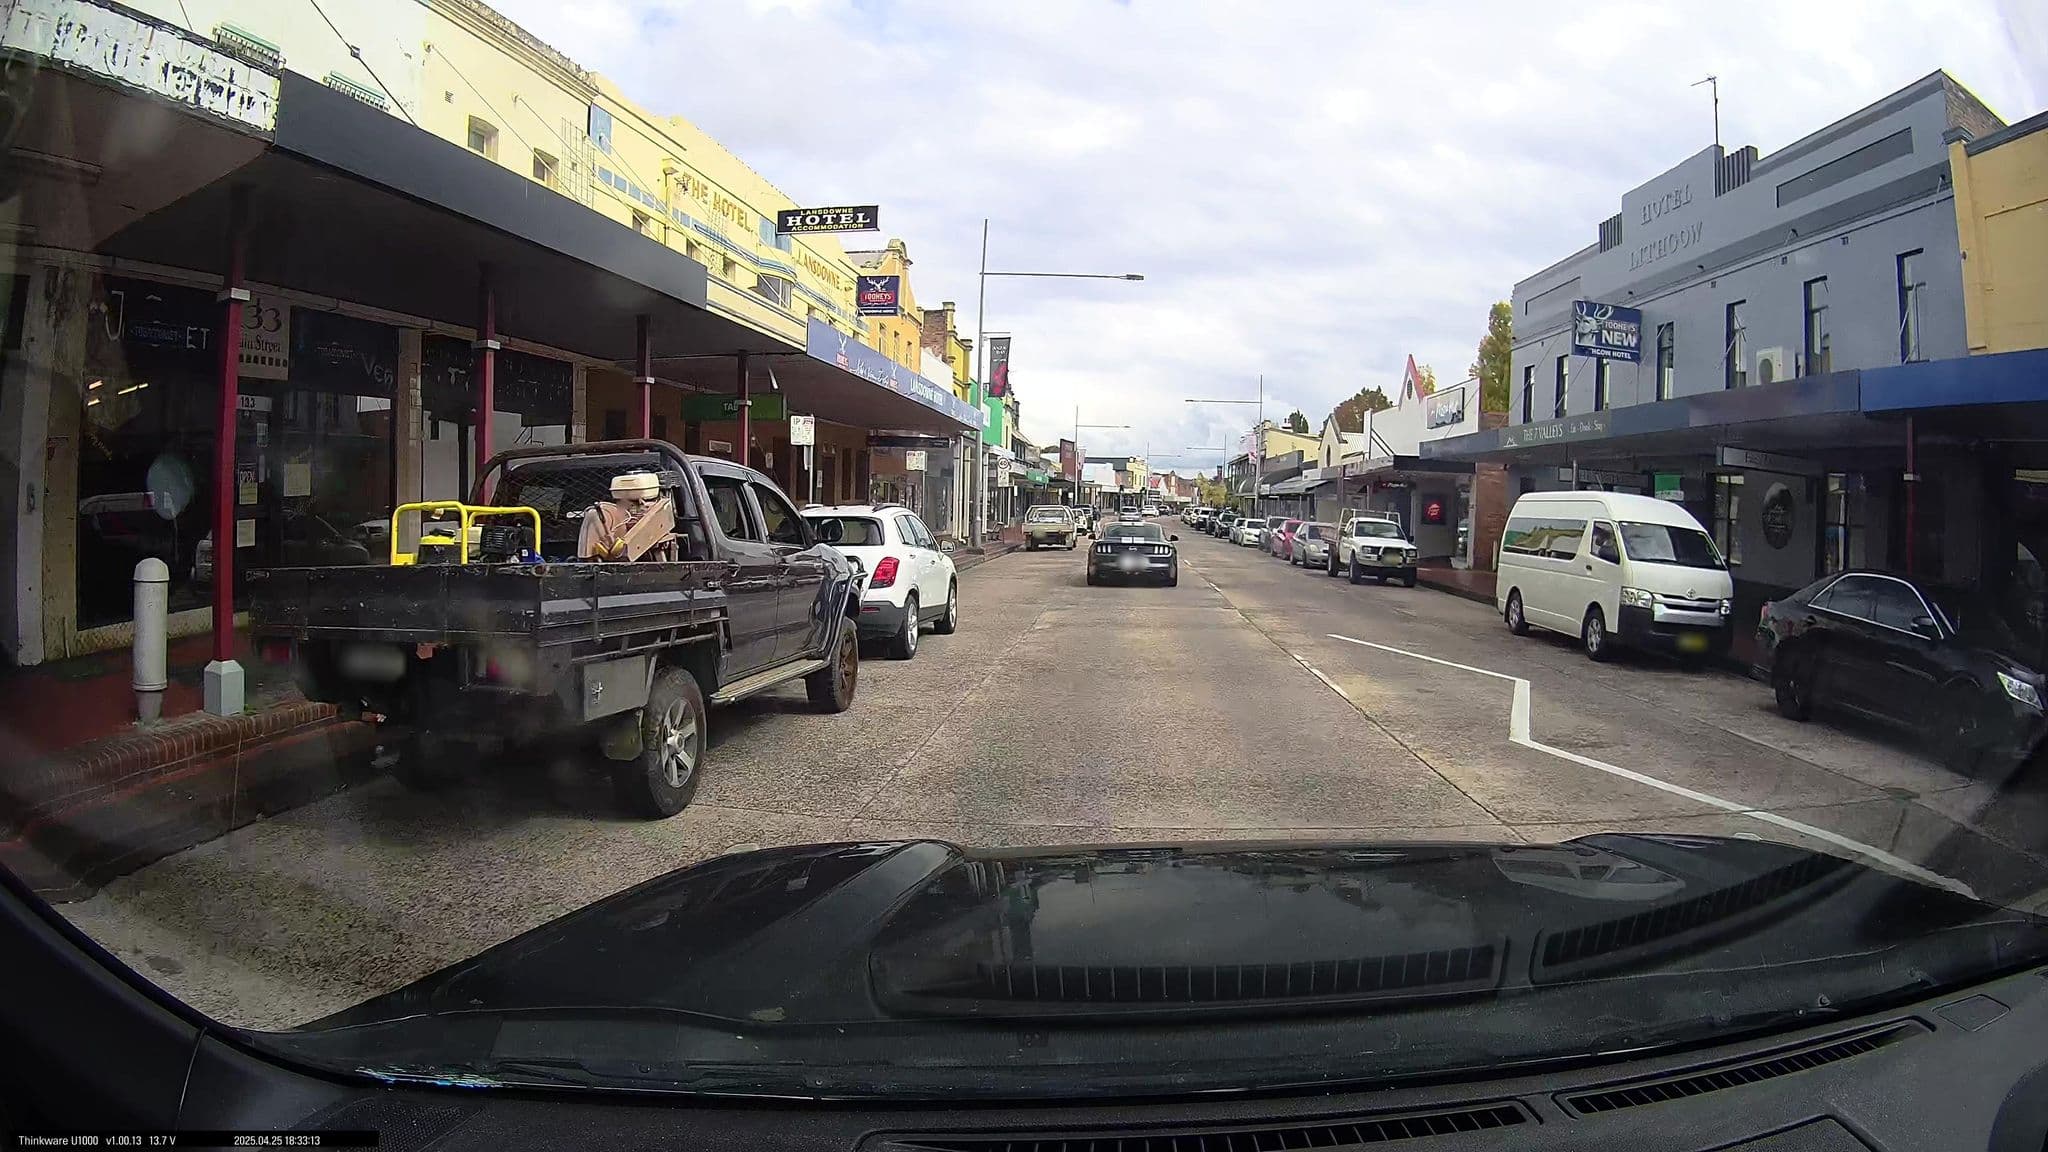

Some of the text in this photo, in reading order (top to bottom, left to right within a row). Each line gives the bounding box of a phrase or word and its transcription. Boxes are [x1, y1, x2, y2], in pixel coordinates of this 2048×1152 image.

[683, 172, 708, 205] THE
[800, 207, 854, 216] LANSDOWNE
[1640, 184, 1693, 226] HOTEL
[786, 212, 870, 227] HOTEL
[791, 223, 864, 232] ACCOMMODATION
[1628, 221, 1703, 273] LITHGOW
[1604, 321, 1636, 332] TOOHES
[1602, 329, 1637, 348] NEW
[1612, 351, 1632, 359] HOTEL
